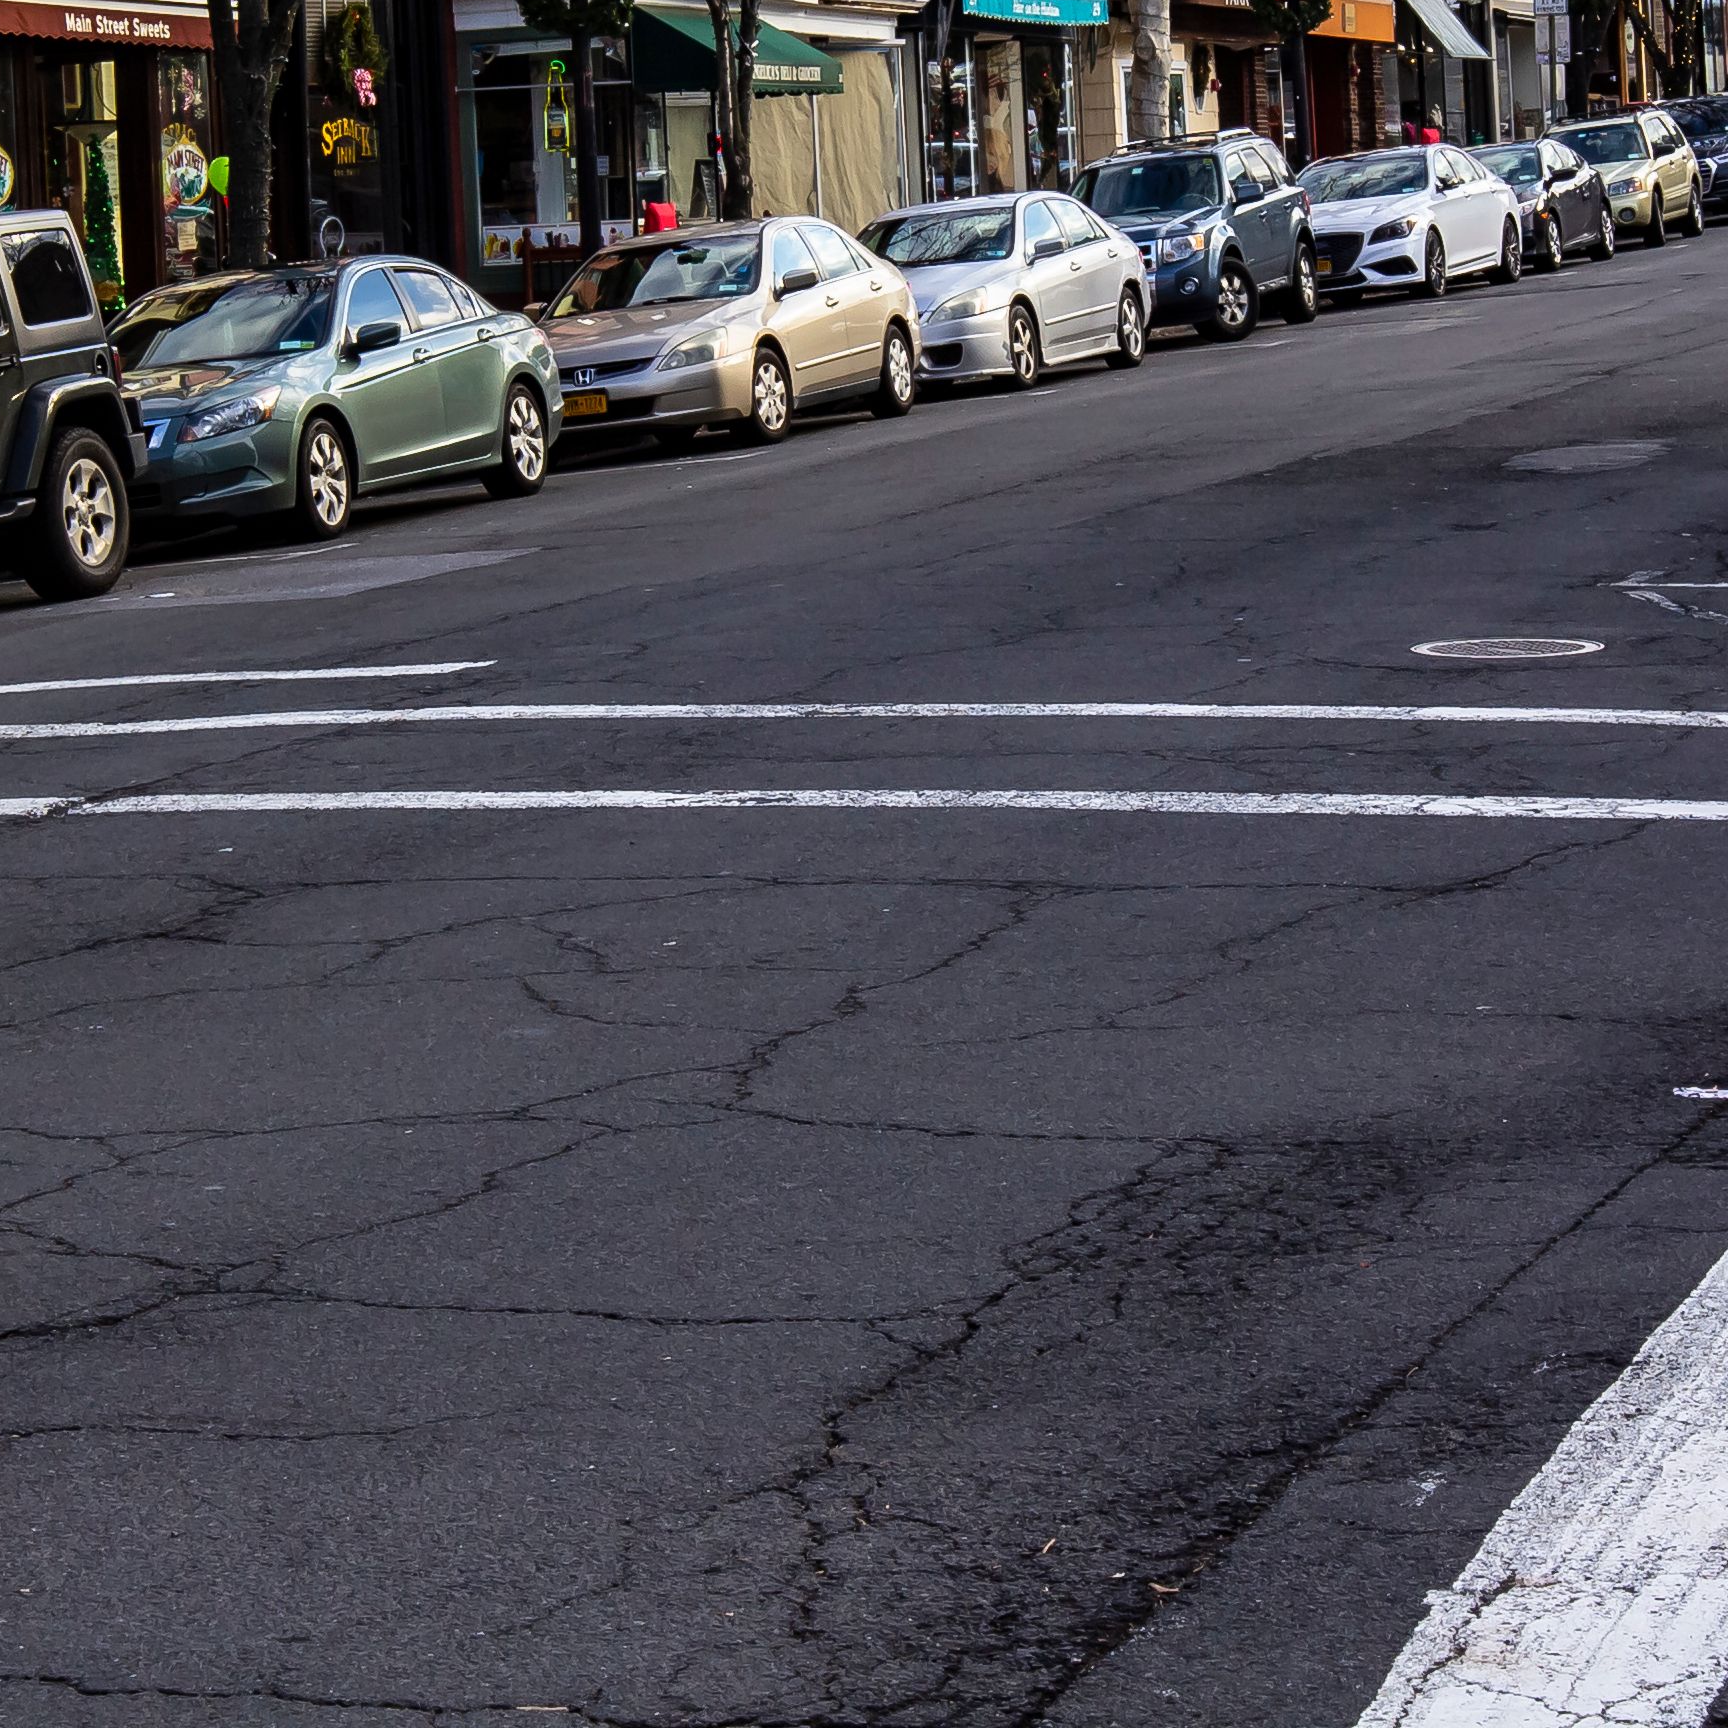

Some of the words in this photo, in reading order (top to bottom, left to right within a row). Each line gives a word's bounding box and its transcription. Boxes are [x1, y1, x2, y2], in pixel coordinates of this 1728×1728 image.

[65, 12, 93, 33] Main
[95, 14, 130, 36] Street
[132, 17, 171, 39] Sweets
